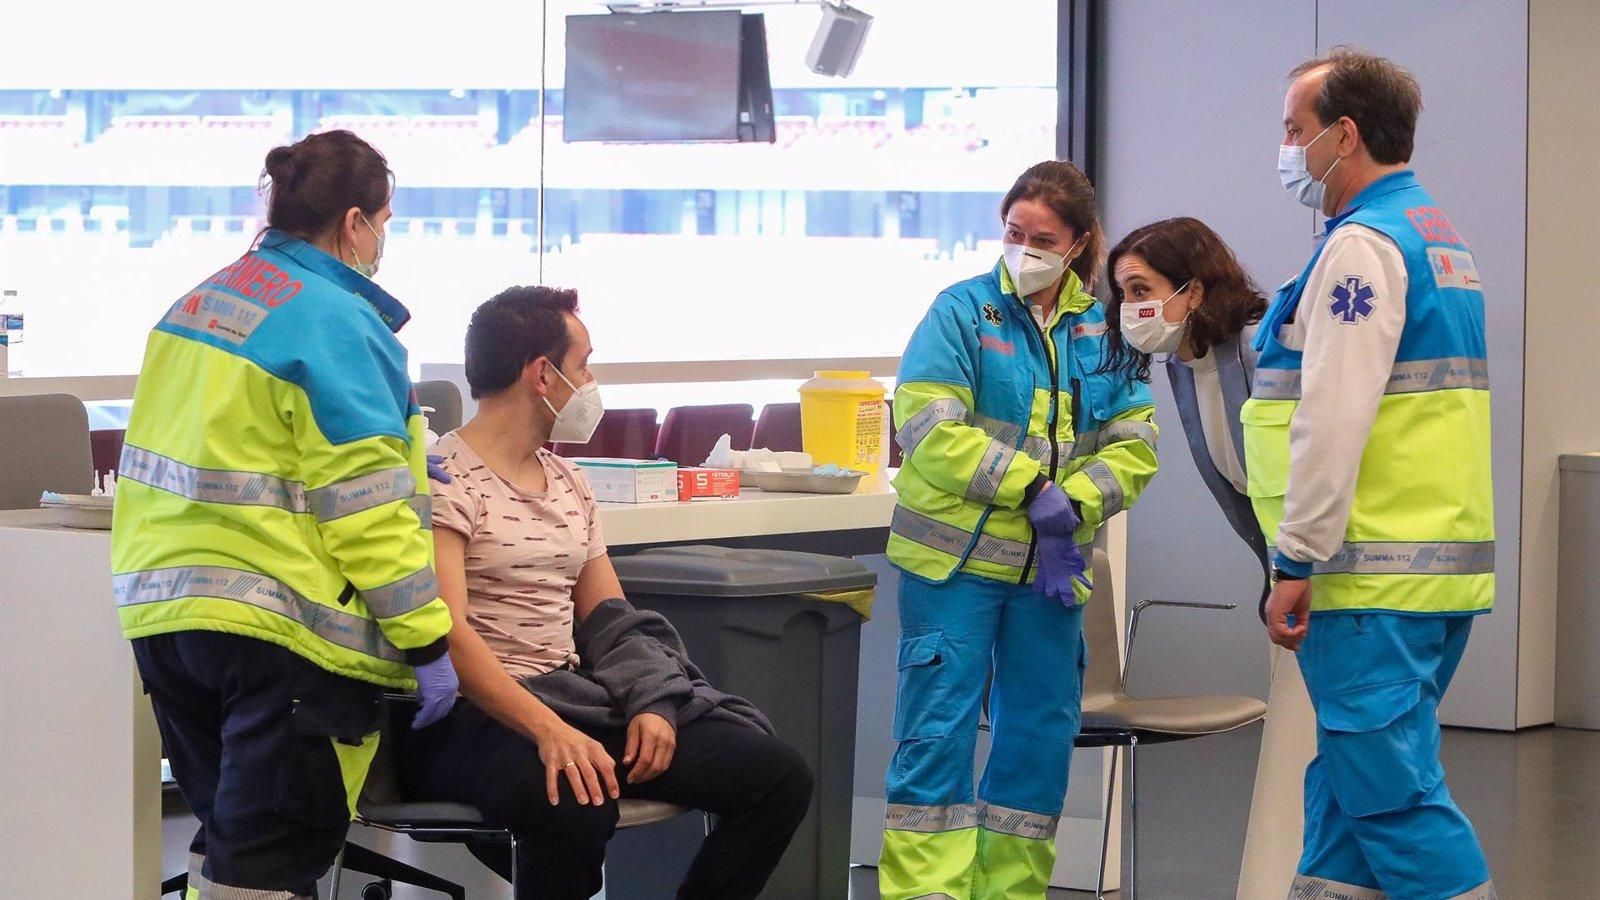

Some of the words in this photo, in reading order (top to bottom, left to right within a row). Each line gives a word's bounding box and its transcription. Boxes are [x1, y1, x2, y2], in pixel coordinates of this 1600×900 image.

[1414, 371, 1429, 380] 112
[375, 481, 390, 493] 112
[1363, 554, 1394, 562] SUMMA
[1398, 554, 1411, 562] 112
